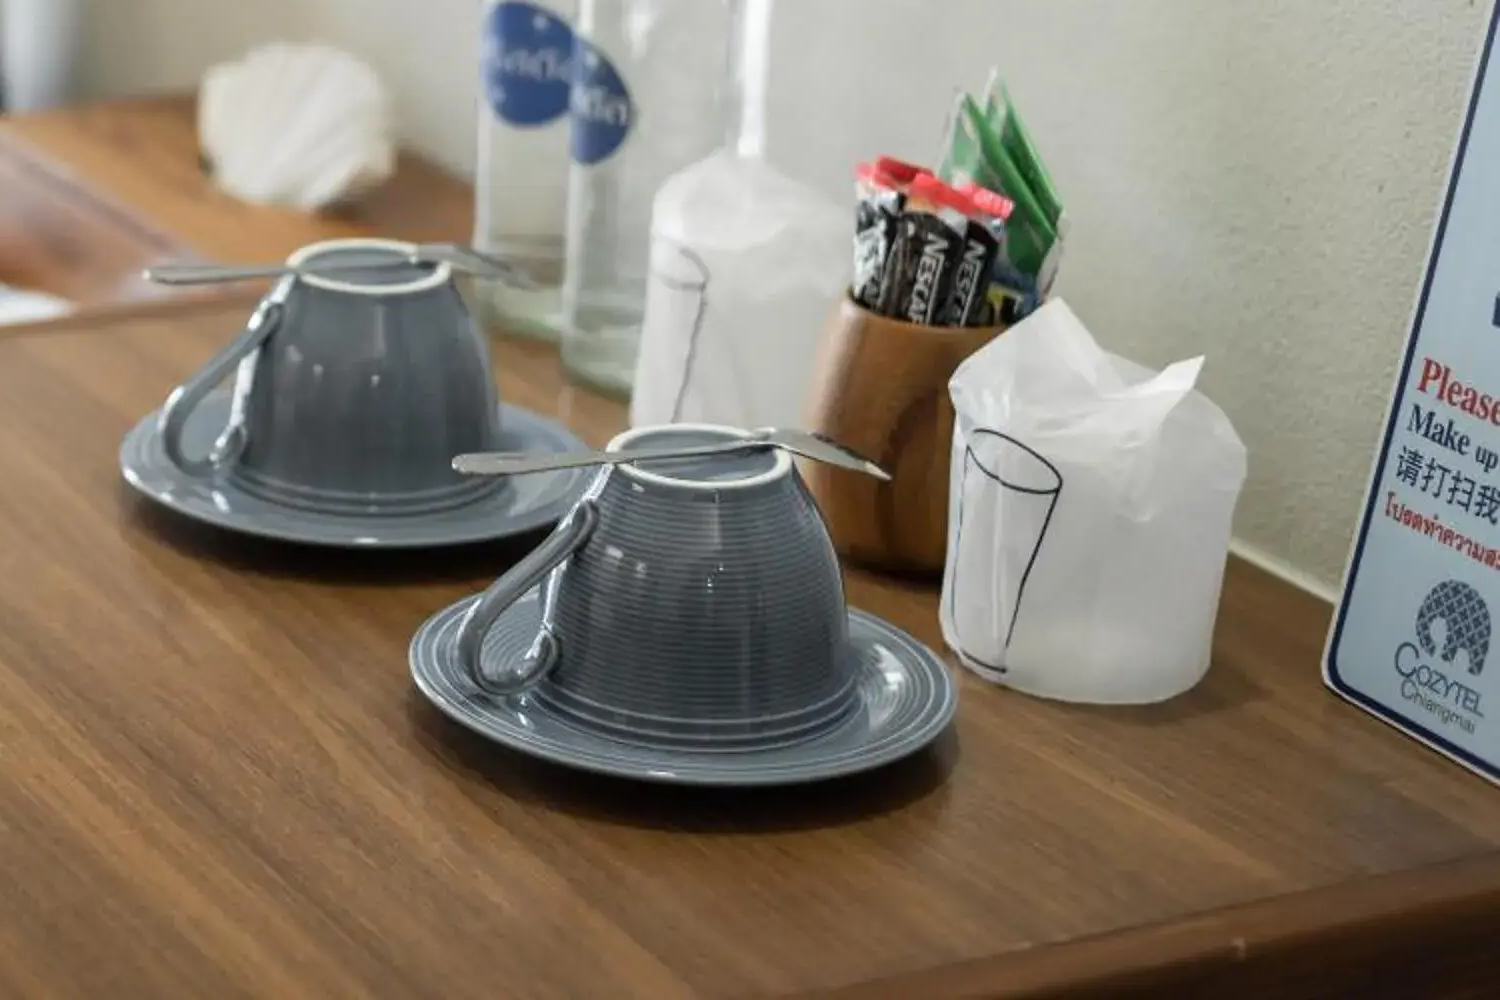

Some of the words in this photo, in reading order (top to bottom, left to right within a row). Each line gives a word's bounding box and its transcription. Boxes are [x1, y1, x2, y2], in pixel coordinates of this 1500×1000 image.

[1416, 356, 1500, 426] Please
[1406, 403, 1470, 456] Make
[1475, 445, 1499, 473] up
[1396, 445, 1500, 525] 请打扫我
